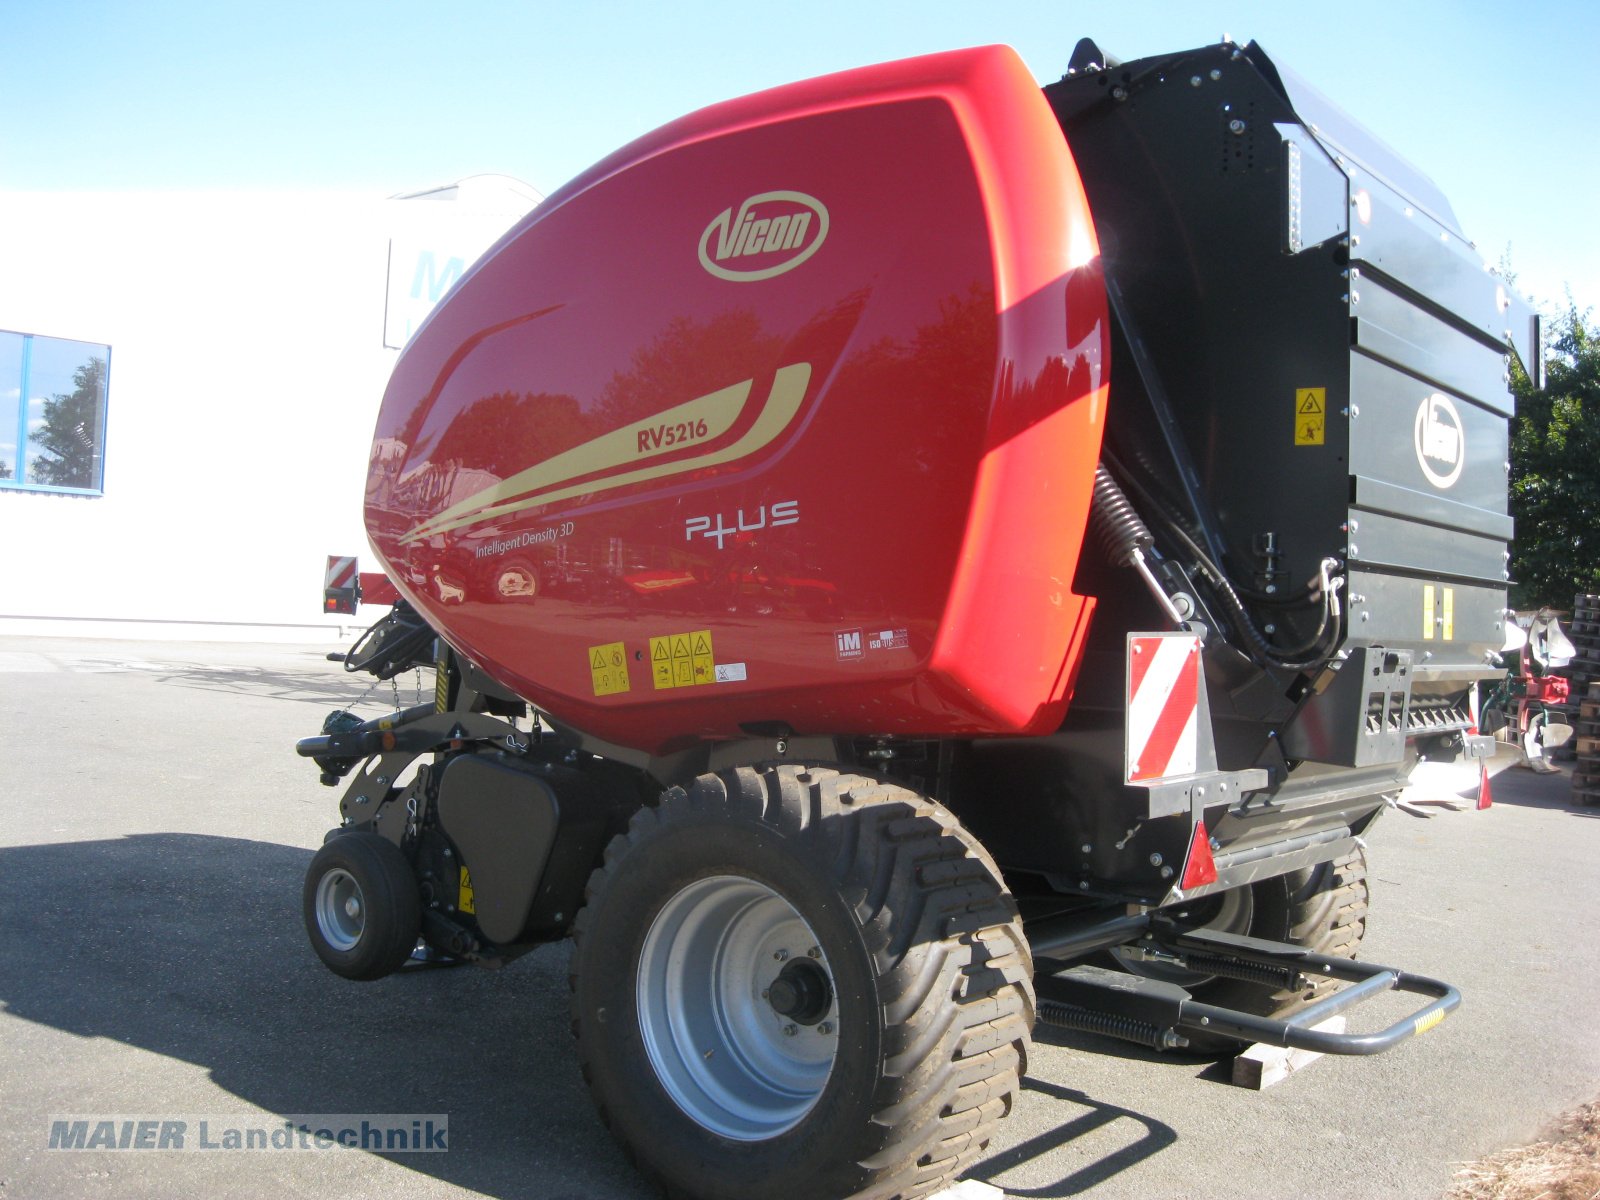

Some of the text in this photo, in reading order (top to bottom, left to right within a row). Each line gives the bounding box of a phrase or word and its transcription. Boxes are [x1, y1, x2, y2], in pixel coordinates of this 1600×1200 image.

[712, 198, 812, 260] Vicon
[637, 418, 708, 453] RV5216
[475, 521, 575, 558] Intelligent Density 3D
[685, 500, 800, 550] PLUS
